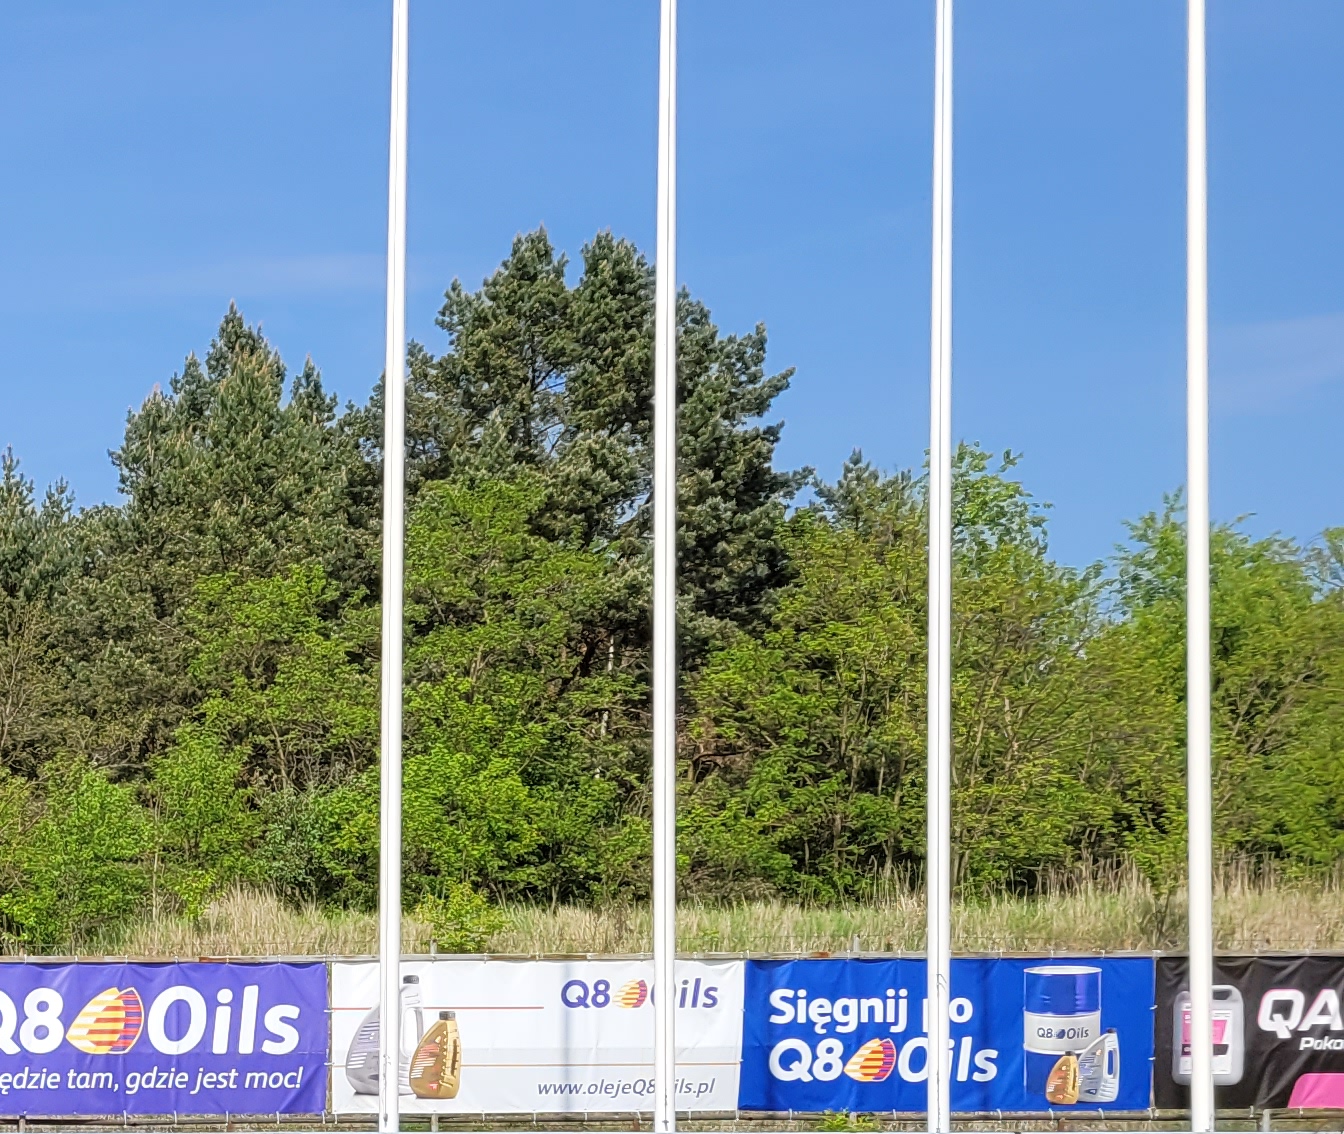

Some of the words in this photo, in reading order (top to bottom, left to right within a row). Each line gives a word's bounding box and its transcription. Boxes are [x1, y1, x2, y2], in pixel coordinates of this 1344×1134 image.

[561, 978, 611, 1009] Q8
[650, 977, 719, 1009] ils
[147, 985, 301, 1055] Oils
[768, 988, 909, 1034] Sięgnij
[1037, 1027, 1053, 1038] Q8
[1066, 1027, 1089, 1039] Oils
[768, 1038, 845, 1082] Q8
[67, 1068, 119, 1092] tam,
[125, 1066, 189, 1094] gdzie
[190, 1066, 239, 1095] jest
[244, 1066, 304, 1089] moc!
[537, 1077, 715, 1098] www.olejeQ8ils.pl
